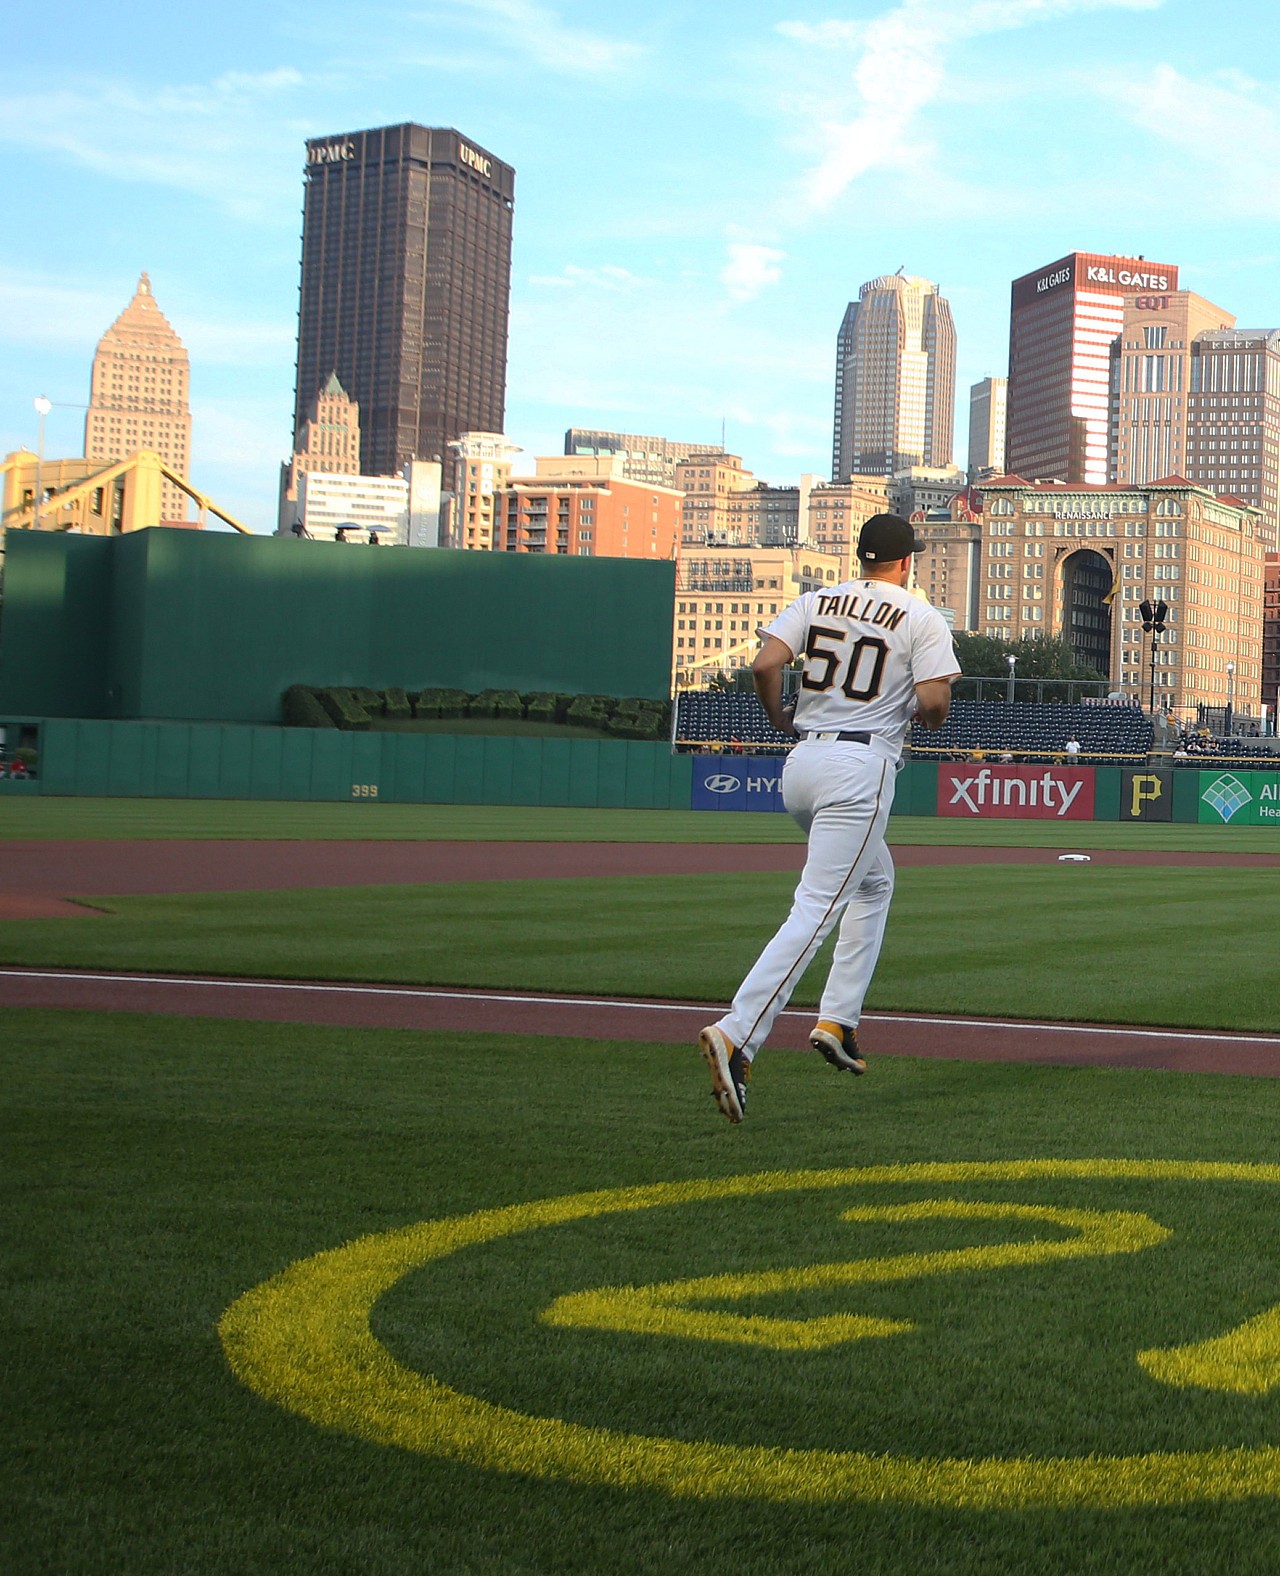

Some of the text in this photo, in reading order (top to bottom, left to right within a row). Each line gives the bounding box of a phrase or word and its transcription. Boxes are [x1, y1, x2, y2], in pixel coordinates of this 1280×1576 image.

[460, 143, 492, 178] UPMC
[1036, 267, 1070, 293] K&L GATES
[1087, 266, 1168, 291] K&L GATES
[1135, 294, 1172, 311] EQT
[1055, 511, 1114, 520] RENAISSANCE
[817, 594, 907, 632] TAILLON
[802, 624, 891, 702] 50
[352, 784, 378, 797] 399
[949, 769, 1084, 816] xfinity
[1130, 774, 1162, 817] P
